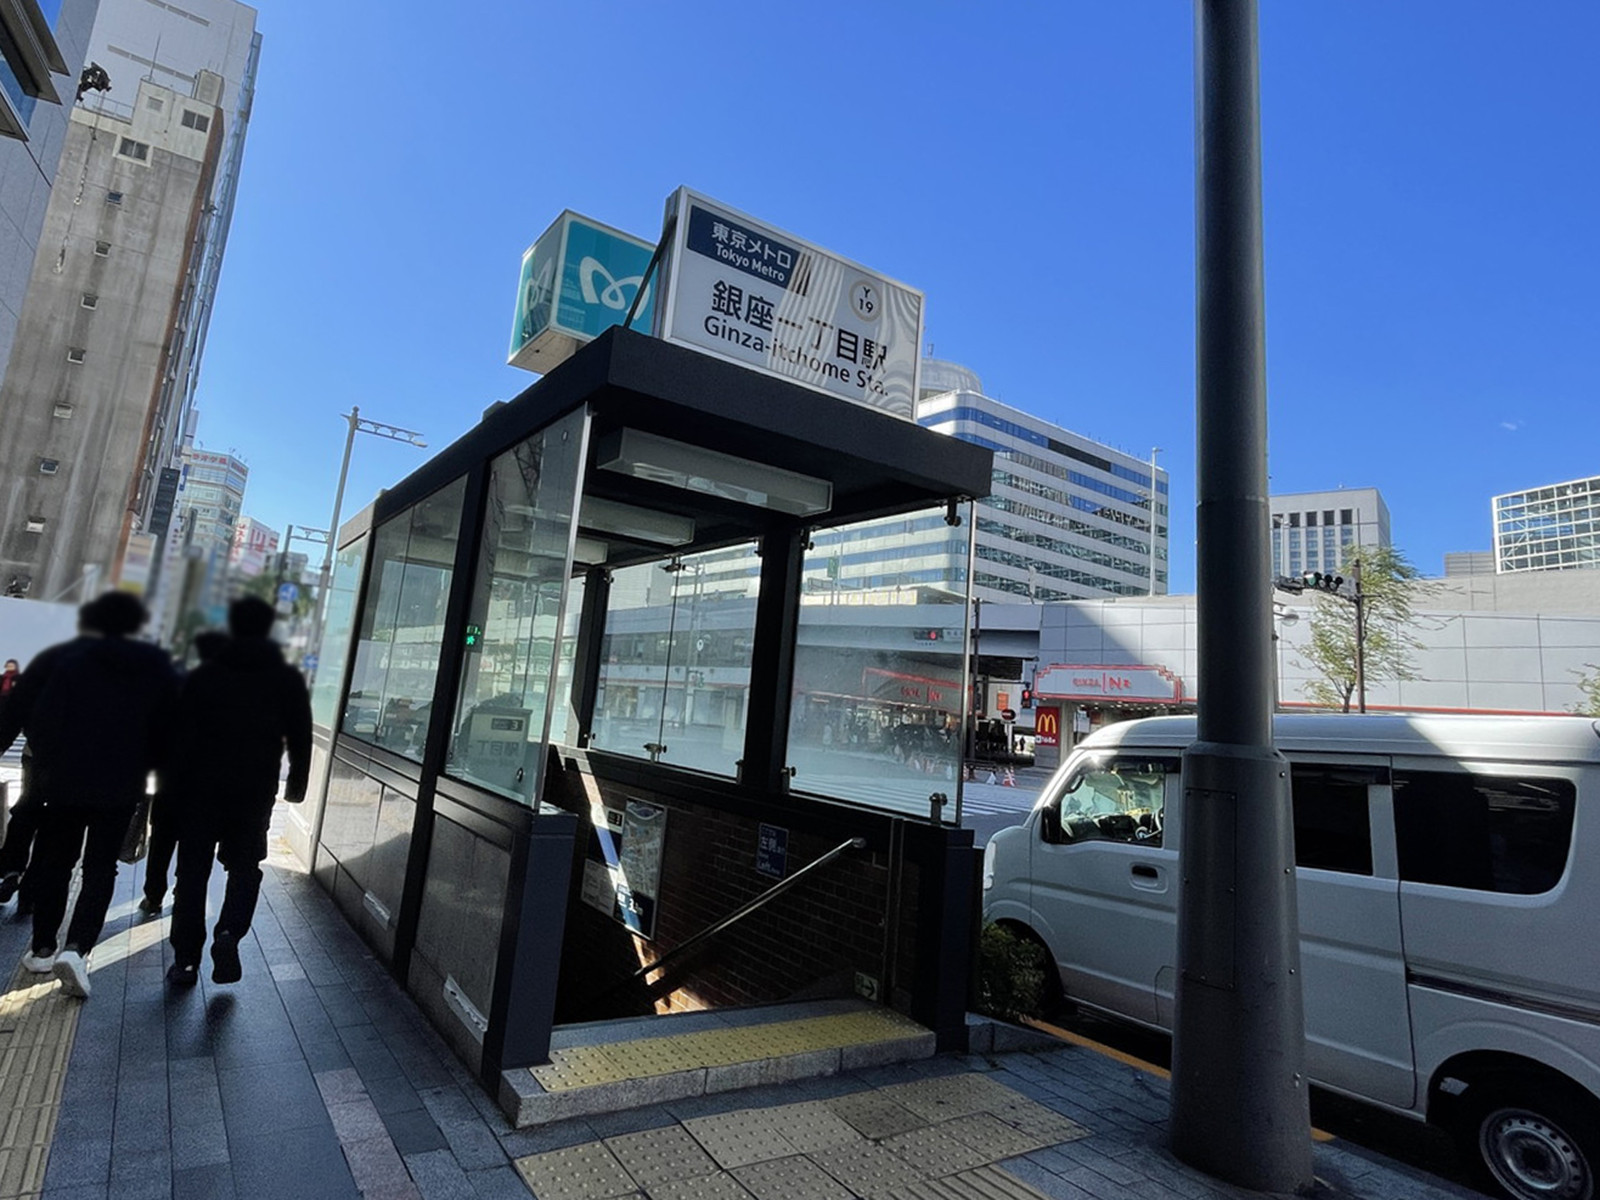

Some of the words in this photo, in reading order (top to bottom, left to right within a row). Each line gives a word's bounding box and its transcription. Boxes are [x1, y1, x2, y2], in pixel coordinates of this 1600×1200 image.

[711, 221, 792, 270] 東京メトロ
[715, 242, 750, 268] Tokyo
[751, 257, 786, 283] Metro
[859, 298, 875, 314] 19
[862, 286, 871, 299] Y
[711, 279, 889, 374] 銀座一丁目駅
[703, 314, 851, 384] Ginza-itchome
[856, 369, 889, 397] Sta.
